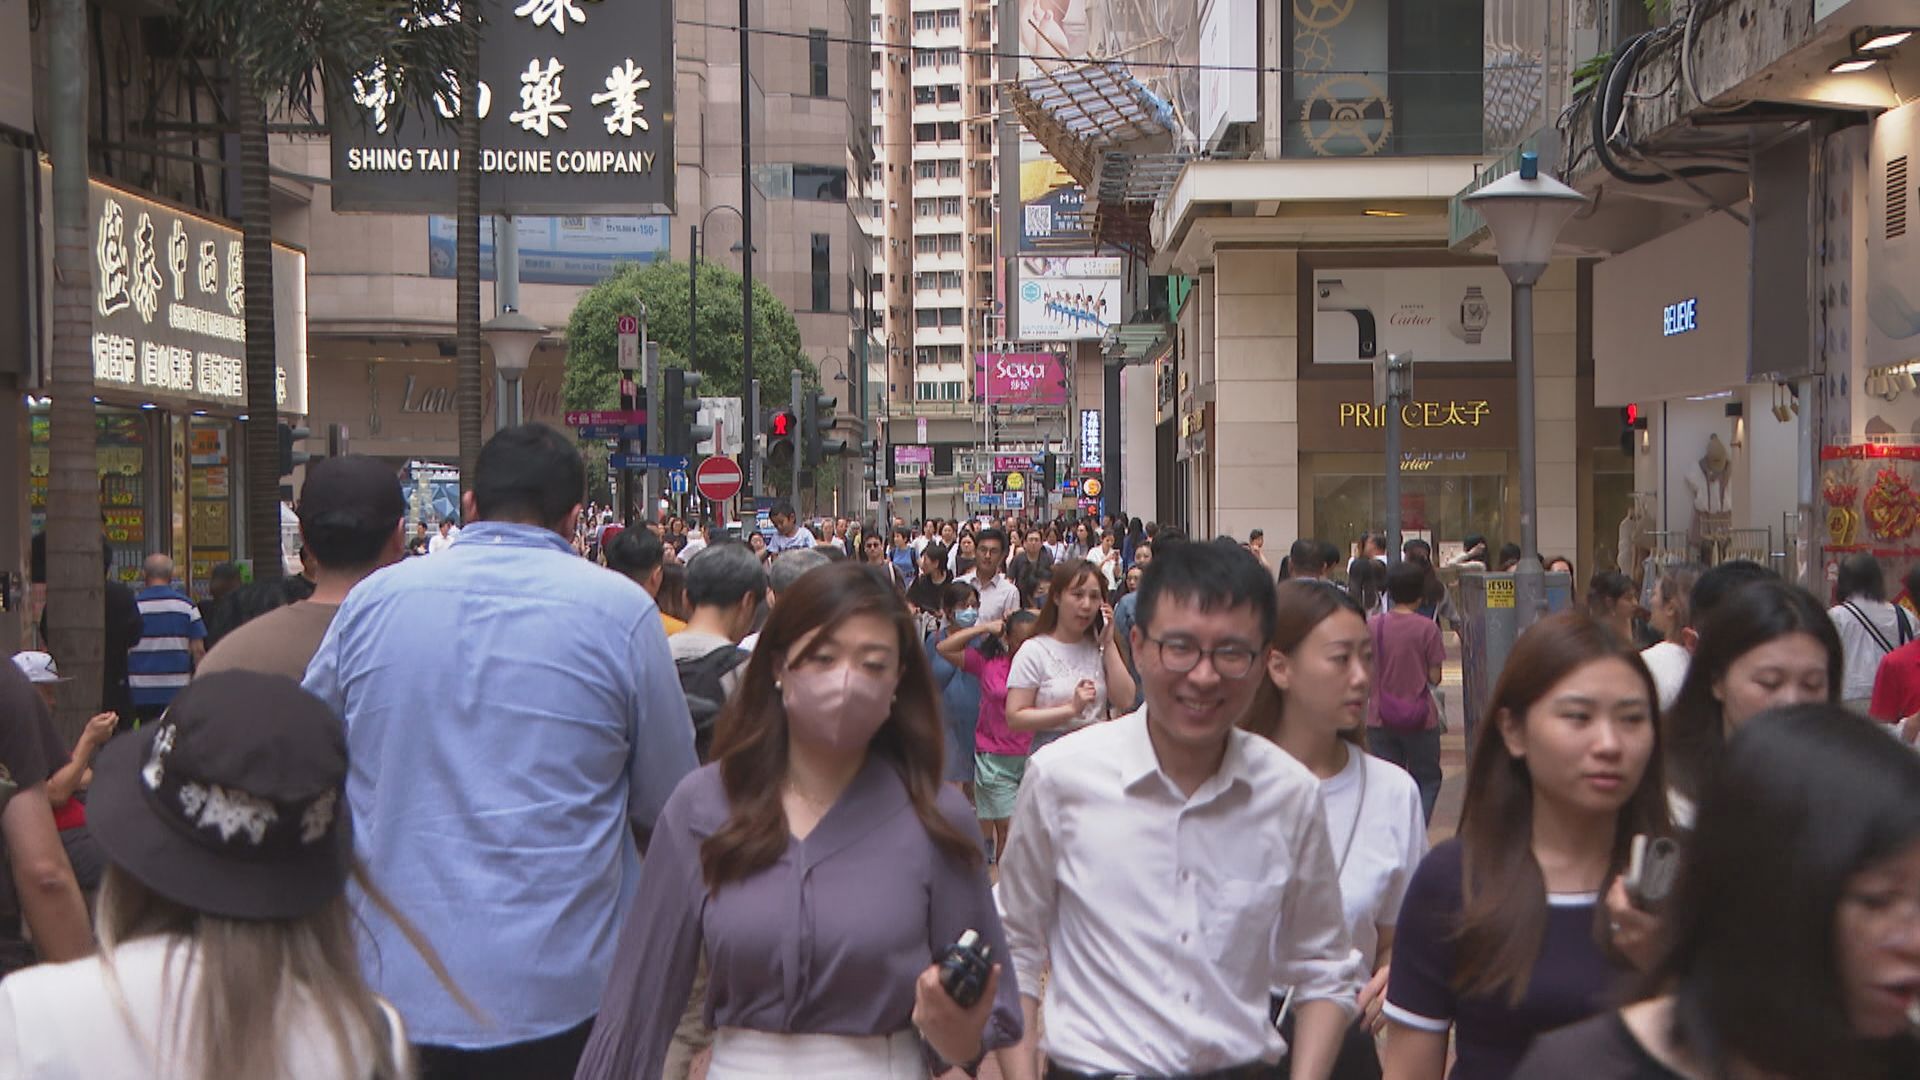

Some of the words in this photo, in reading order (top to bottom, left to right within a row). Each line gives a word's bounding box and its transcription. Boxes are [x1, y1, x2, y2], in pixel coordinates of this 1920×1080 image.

[348, 148, 413, 171] SHING
[417, 148, 448, 170] TAI
[453, 150, 551, 172] DICINE
[556, 151, 656, 173] COMPANY
[1390, 312, 1435, 326] Cartier
[1664, 299, 1696, 336] BELIEVE
[1488, 581, 1514, 590] JESUS
